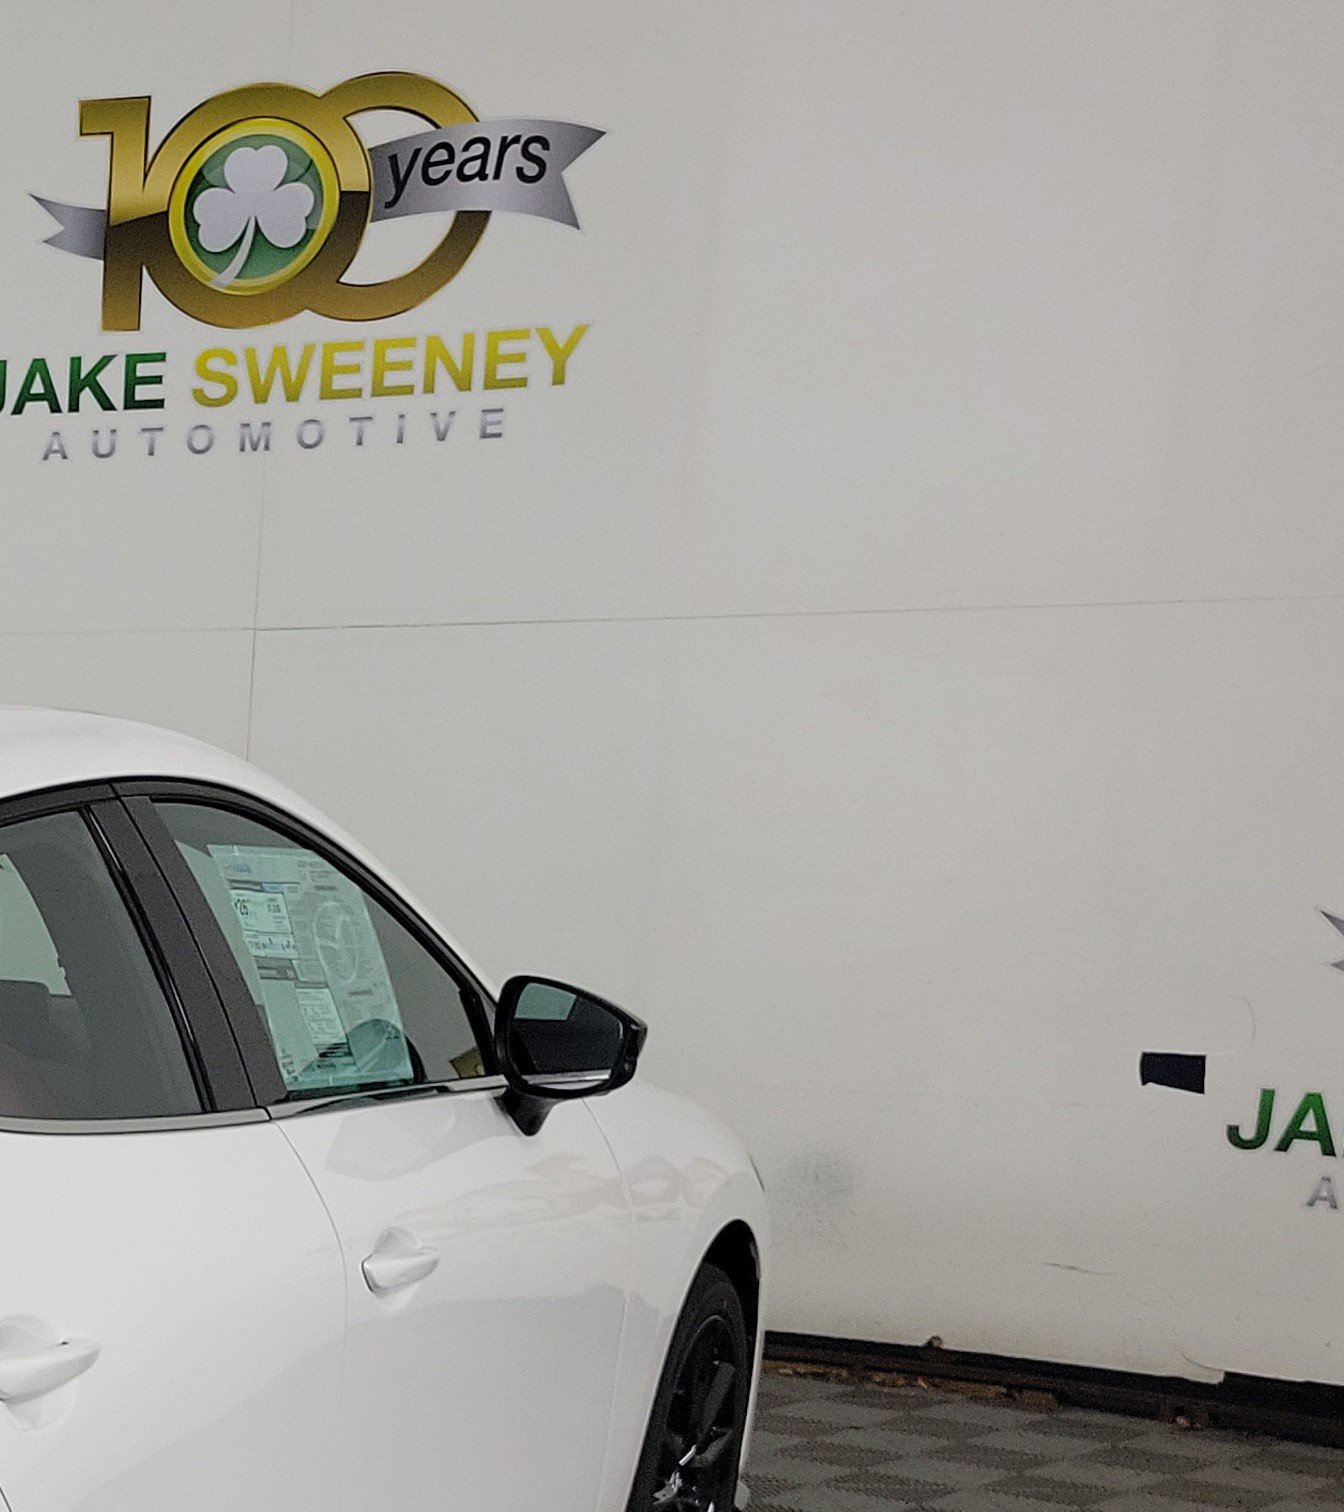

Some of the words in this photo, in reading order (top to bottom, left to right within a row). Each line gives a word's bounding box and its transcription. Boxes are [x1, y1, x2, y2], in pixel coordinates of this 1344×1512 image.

[79, 71, 493, 332] 100
[384, 132, 551, 208] years
[190, 324, 590, 409] SWEENEY
[41, 408, 505, 462] AUTOMOTIVE
[1226, 1088, 1344, 1158] JA
